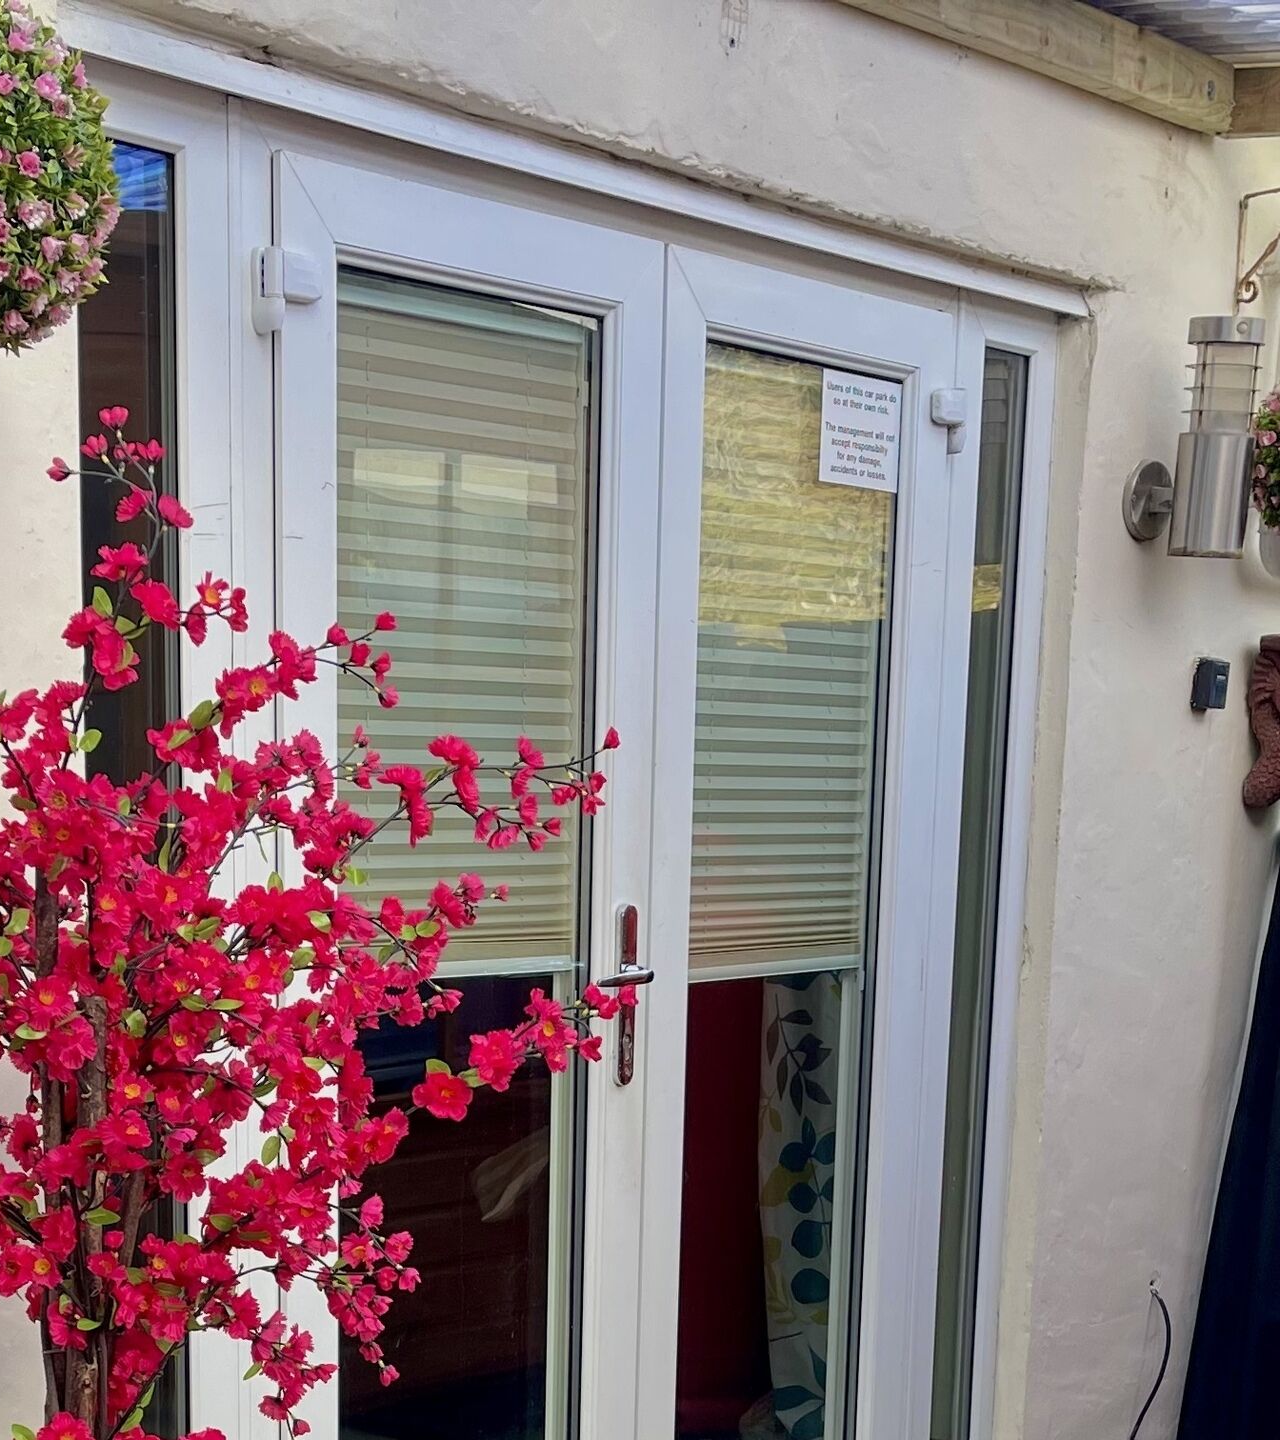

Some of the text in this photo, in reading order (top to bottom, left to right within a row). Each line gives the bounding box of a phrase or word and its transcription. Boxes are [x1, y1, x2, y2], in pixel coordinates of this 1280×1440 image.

[827, 381, 897, 403] Users of this car park do
[833, 397, 841, 405] so
[842, 399, 848, 407] at
[850, 399, 862, 409] their
[864, 403, 876, 412] own
[825, 421, 896, 442] The management will not
[831, 438, 851, 449] accept
[836, 450, 845, 460] for
[846, 454, 857, 464] any
[830, 464, 858, 476] accidents
[859, 469, 865, 477] or
